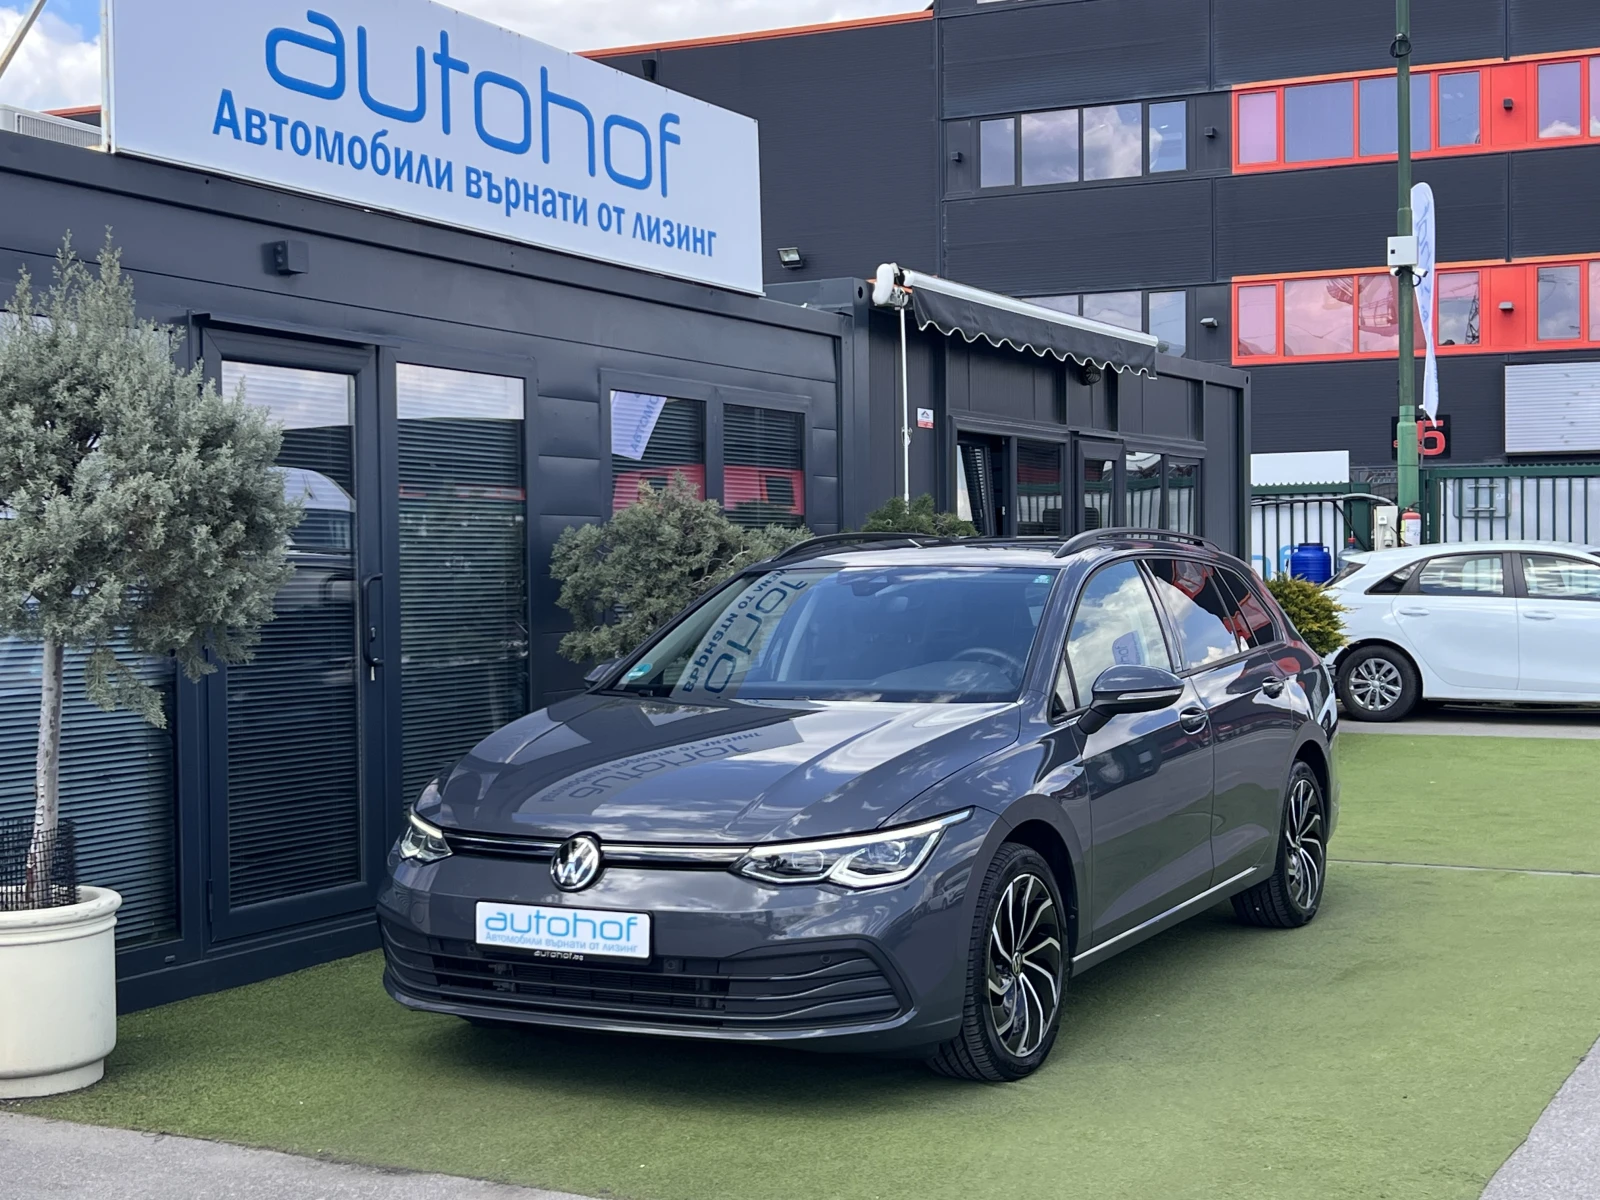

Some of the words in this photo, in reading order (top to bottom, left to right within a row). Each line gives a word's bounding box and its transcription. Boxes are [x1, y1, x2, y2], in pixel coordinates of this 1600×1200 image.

[265, 9, 681, 198] autohof
[212, 88, 453, 192] Автомобили
[465, 165, 588, 227] върнати
[597, 202, 626, 235] от
[632, 211, 717, 257] лизинг
[485, 909, 638, 942] autohof
[485, 931, 542, 946] Автомобили
[545, 939, 586, 949] върнати
[589, 942, 600, 951] от
[603, 943, 639, 953] лизинг
